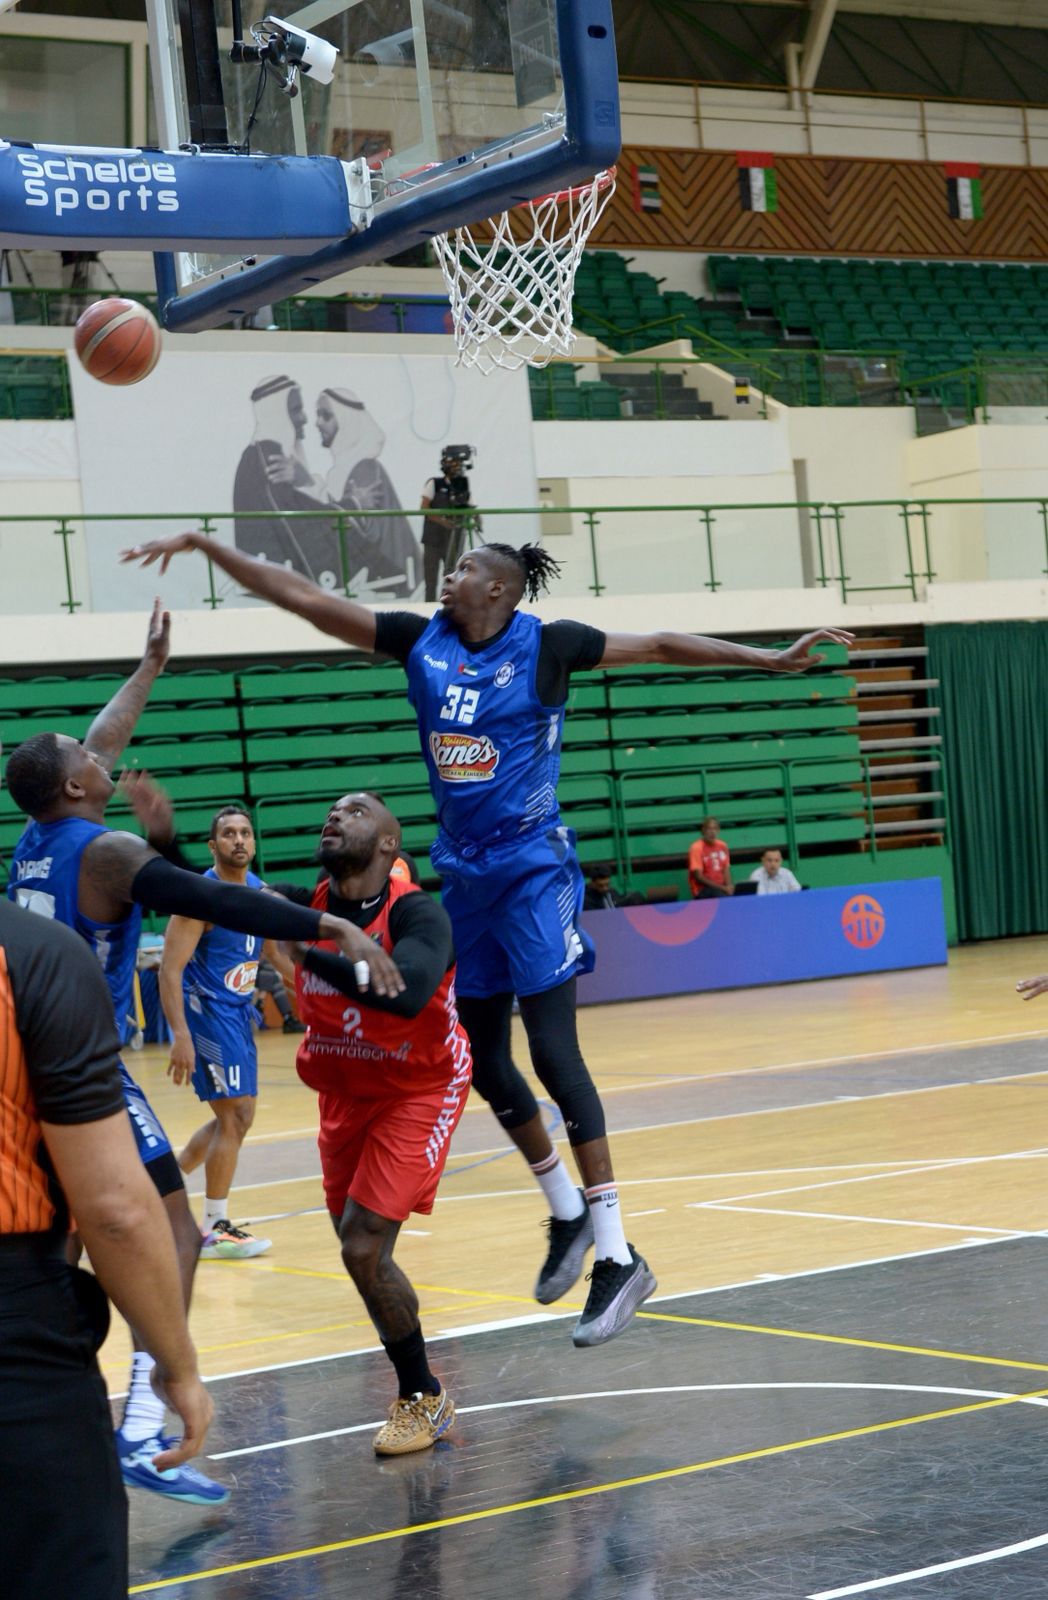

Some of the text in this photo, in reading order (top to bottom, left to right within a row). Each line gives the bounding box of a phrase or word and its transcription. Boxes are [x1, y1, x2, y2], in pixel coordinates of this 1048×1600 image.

[24, 179, 180, 216] Sports
[440, 684, 481, 724] 32
[229, 1064, 241, 1091] 4
